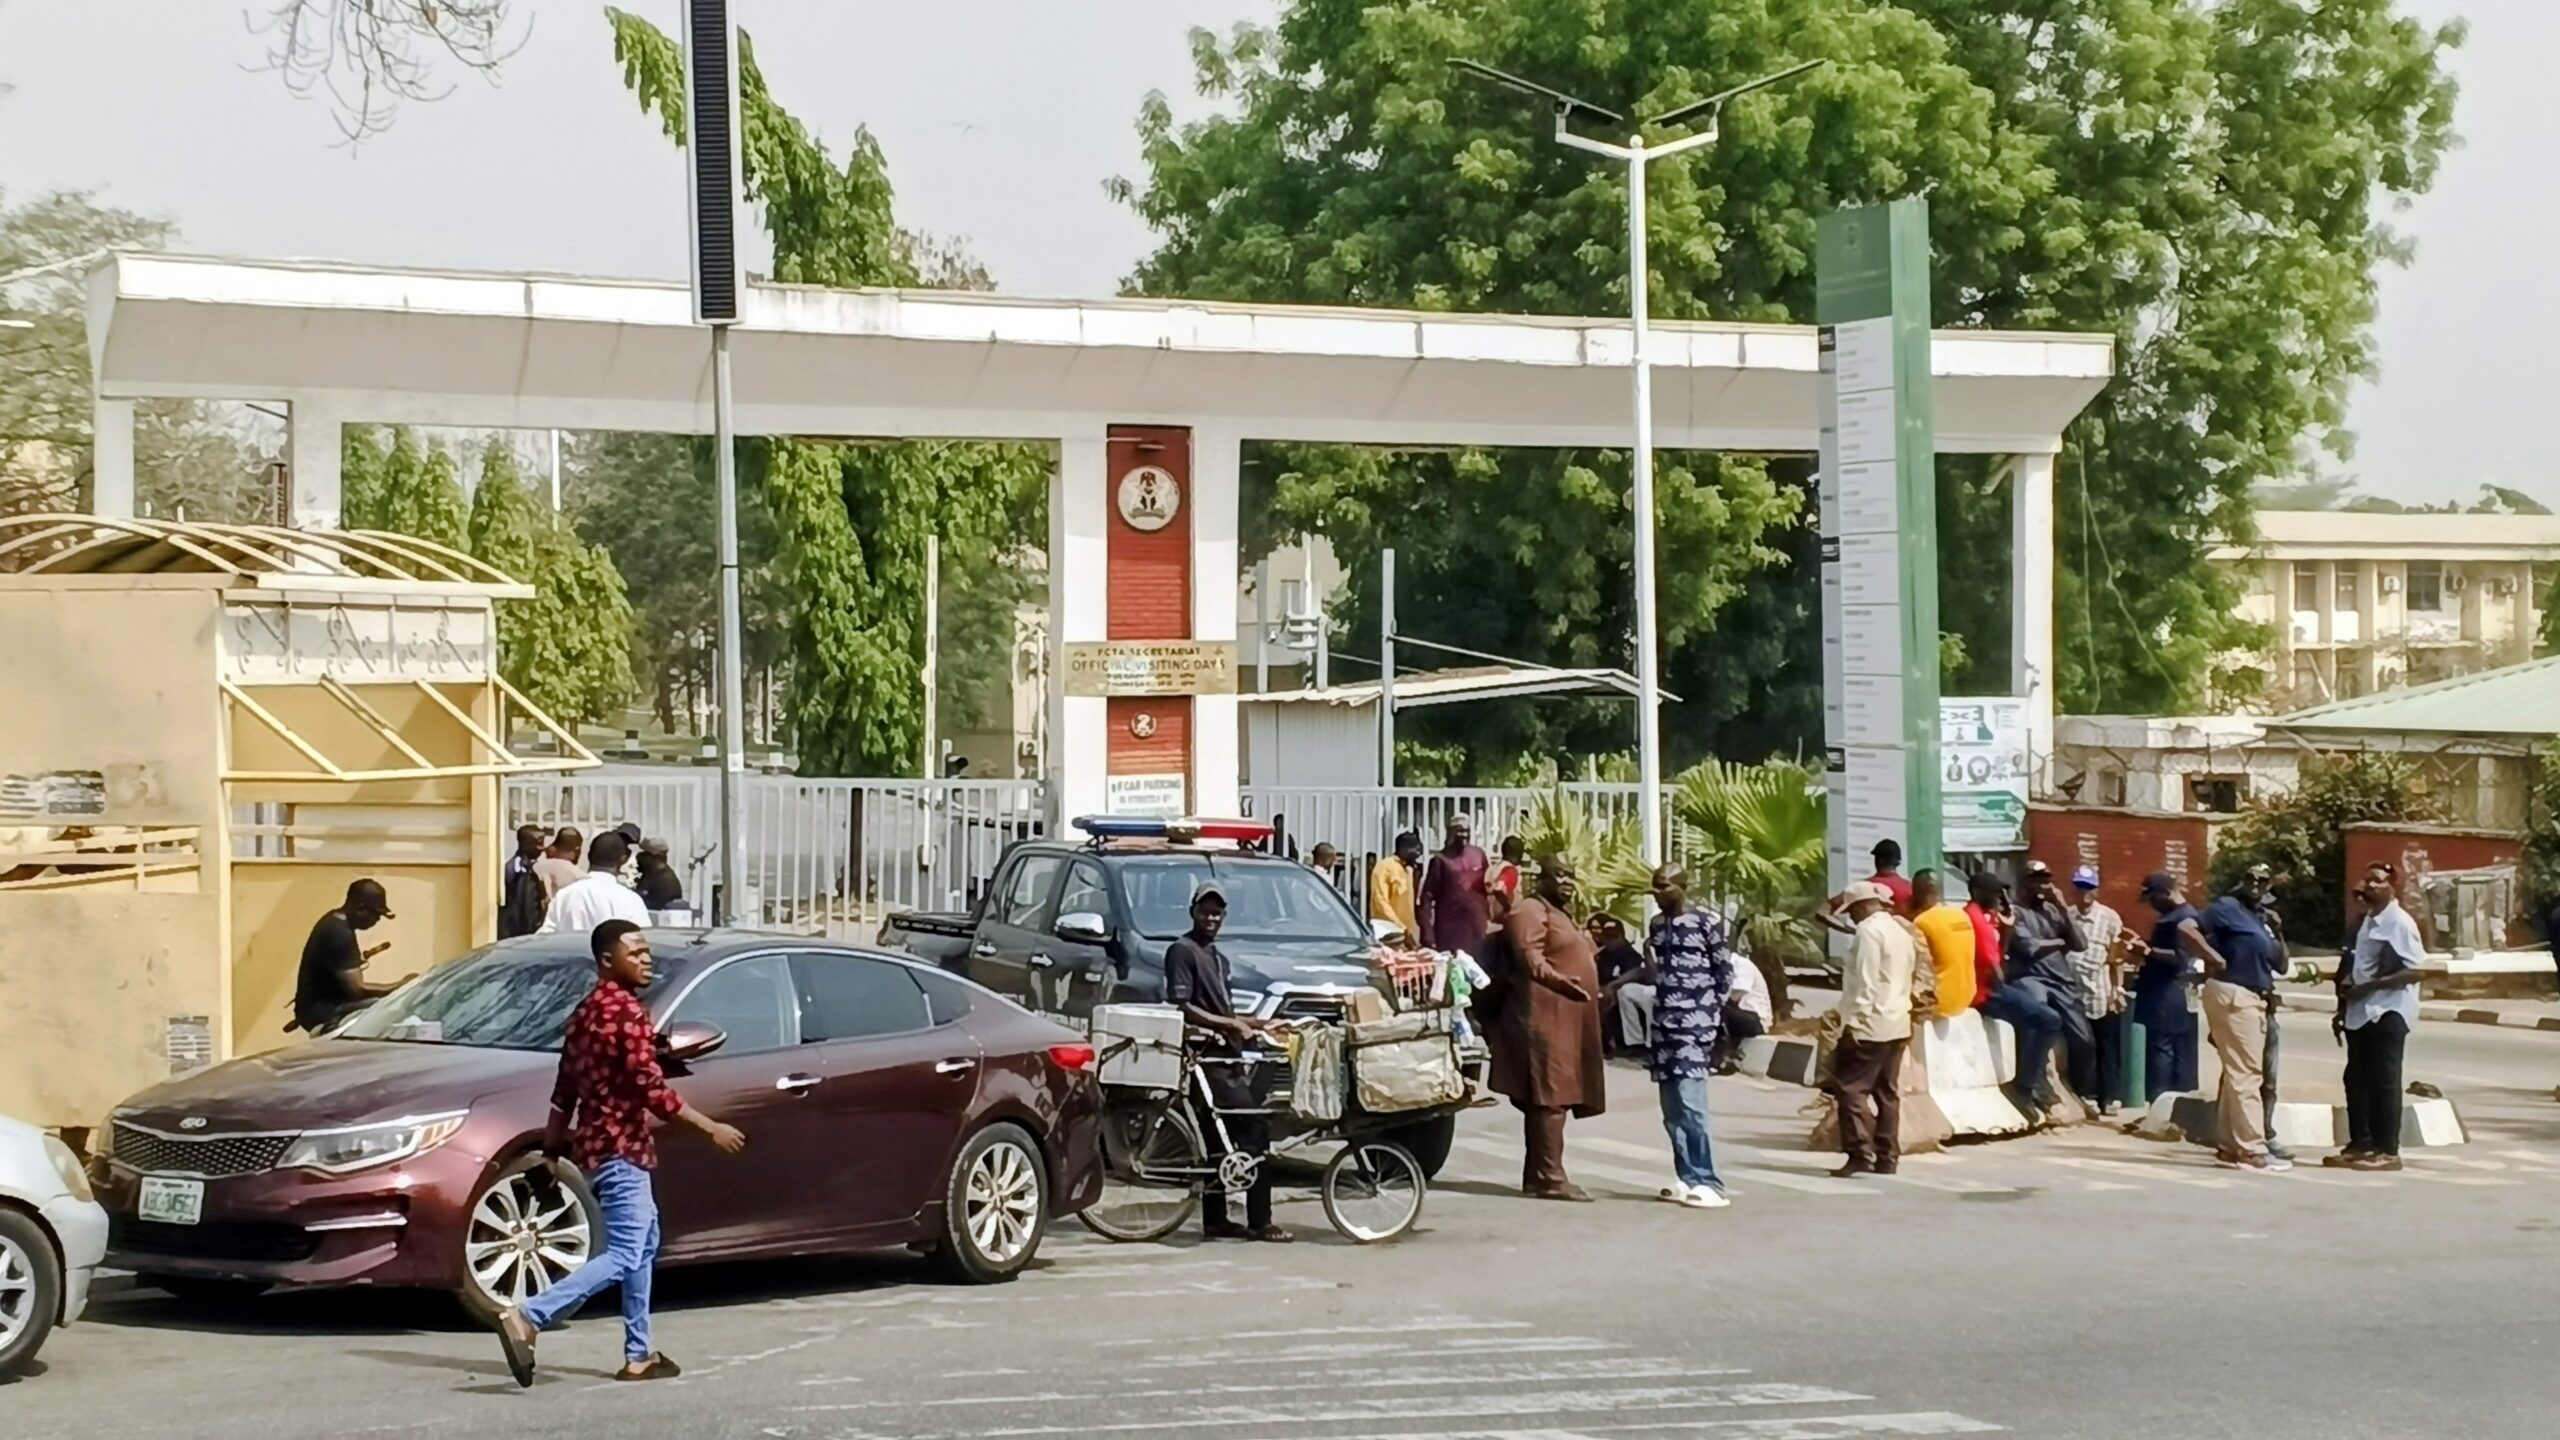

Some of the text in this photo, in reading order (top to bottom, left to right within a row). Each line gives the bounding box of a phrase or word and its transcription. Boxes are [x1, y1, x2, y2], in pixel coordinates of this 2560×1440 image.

[1072, 659, 1226, 671] OFFICIAL VISITING DAYS
